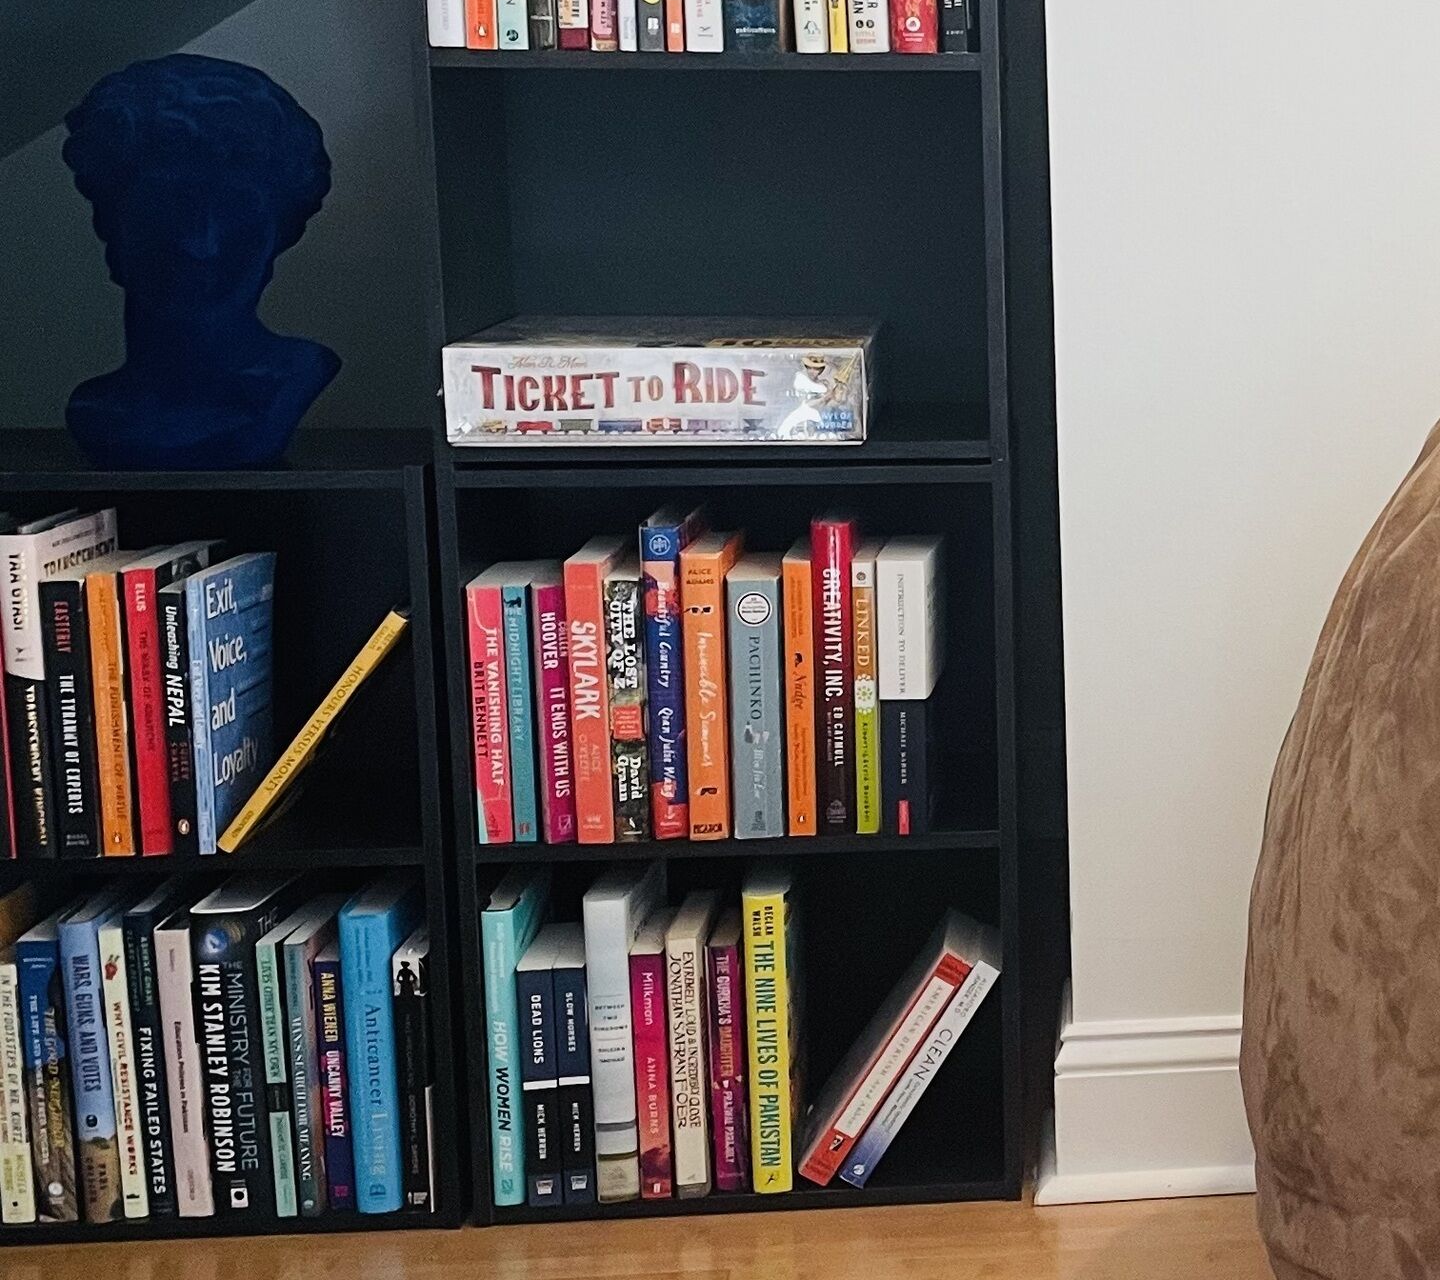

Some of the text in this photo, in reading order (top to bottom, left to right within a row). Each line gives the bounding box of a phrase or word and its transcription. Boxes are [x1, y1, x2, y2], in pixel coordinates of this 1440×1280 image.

[627, 376, 664, 402] TO
[54, 601, 71, 653] EASTERLY
[135, 583, 146, 612] ELLIS
[205, 578, 237, 620] Exit,
[208, 632, 247, 673] Voice,
[508, 617, 522, 682] MIDNIGHT
[541, 612, 559, 670] HOOVER
[611, 651, 624, 672] OF
[622, 600, 638, 689] THE LOST
[654, 580, 673, 688] Beautiful Country
[822, 567, 844, 702] CREATIVITY, INC.
[855, 598, 869, 667] LINKED
[897, 573, 906, 695] INSTRUCTION TO DELIVER
[165, 606, 185, 727] Unleashing NEPAL
[571, 620, 601, 721] SKYLARK
[613, 676, 625, 689] Z
[748, 636, 762, 720] PACHINKO
[791, 672, 807, 710] Nudge
[211, 687, 236, 732] and
[265, 665, 363, 794] HONOURS VERSUS MONEY
[474, 661, 489, 758] BRIT BENNETT
[486, 627, 505, 786] THE VANISHING HALF
[511, 687, 524, 741] LIBRARY
[833, 706, 845, 767] ED CATMULL
[60, 674, 83, 814] THE TYRANNY OF EXPERTS
[213, 735, 258, 787] Loyalty
[550, 687, 570, 798] IT ENDS WITH US
[657, 707, 677, 798] Qian Julie Wang
[617, 755, 629, 802] Grann
[629, 756, 642, 800] David
[753, 910, 761, 937] WALSH
[764, 906, 773, 936] DECLAN
[321, 972, 338, 1042] ANNA WIENER
[683, 951, 695, 1005] EXTREMELY
[227, 973, 249, 1064] MINISTRY
[493, 1020, 507, 1062] HOW
[531, 994, 544, 1064] DEAD LIONS
[565, 992, 576, 1052] SLOW HORSES
[669, 953, 688, 1129] JONATHAN SAFRAN FOER
[685, 1009, 696, 1036] LOUD
[716, 955, 733, 1077] THE GURKHA'S DAUGHTER
[199, 964, 235, 1172] KIM STANLEY ROBINSON
[294, 1054, 306, 1101] SEARCH
[641, 972, 659, 1135] Milkman ANNA BURNS
[688, 1047, 699, 1096] INCREDIBLY
[753, 941, 781, 1167] THE NINE LIVES OF PAKISTAN
[913, 1028, 953, 1081] CLEAN
[112, 1001, 138, 1176] WHY CIVIL RESISTANCE WORKS
[139, 1026, 166, 1194] FIXING FAILED STATES
[297, 1103, 307, 1126] FOR
[325, 1050, 345, 1138] UNCANNY VALLEY
[496, 1067, 511, 1132] WOMEN
[537, 1104, 545, 1124] MICK
[690, 1097, 701, 1128] CLOSE
[237, 1093, 258, 1171] FUTURE
[299, 1128, 311, 1181] MEANING
[499, 1136, 513, 1172] RISE
